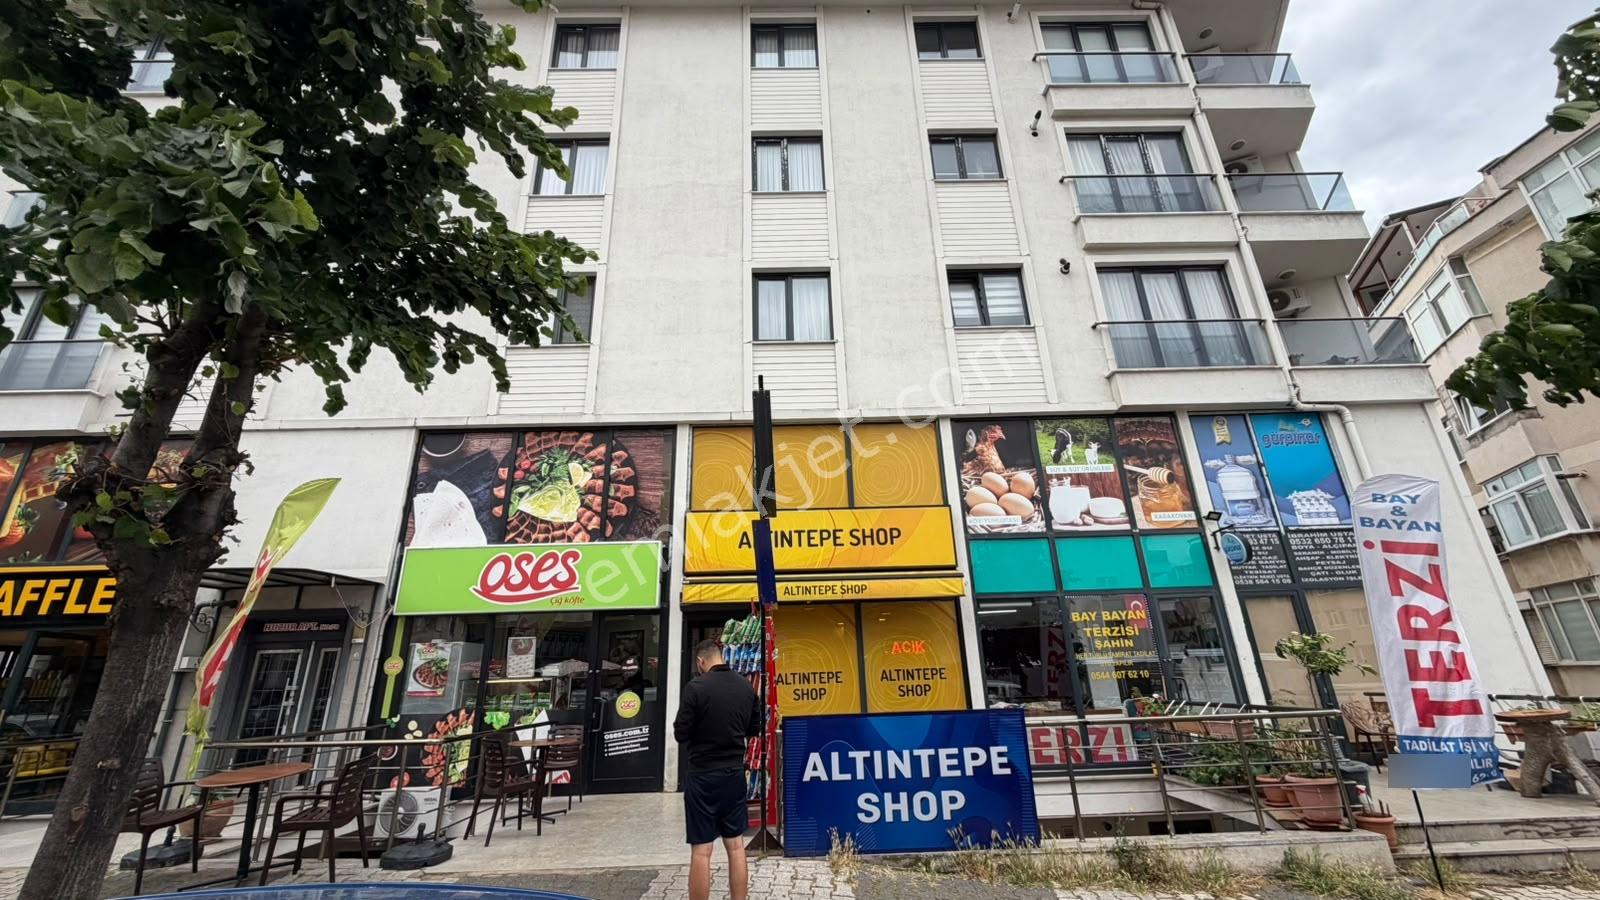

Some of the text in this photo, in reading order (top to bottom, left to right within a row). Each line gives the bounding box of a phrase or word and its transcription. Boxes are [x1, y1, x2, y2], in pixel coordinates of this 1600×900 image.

[1371, 493, 1421, 504] BAY
[1390, 505, 1407, 517] &
[1360, 517, 1441, 532] BAYAN
[738, 527, 902, 549] AINTEPE SHOP
[1287, 531, 1328, 539] İBRAHİM
[479, 549, 581, 596] oses
[783, 584, 868, 596] ALTINTEPE SHOP
[1071, 611, 1097, 622] BAY
[1102, 610, 1146, 620] BAYAN
[1083, 624, 1140, 637] TERZİSİ
[1363, 539, 1484, 729] TERZİ
[1095, 639, 1134, 650] ŞAHİN
[775, 671, 843, 685] ALTINTEPE
[880, 667, 947, 682] ALTINTEPE
[1128, 670, 1138, 678] 62
[1140, 670, 1150, 678] 10
[793, 687, 827, 701] SHOP
[898, 684, 932, 697] SHOP
[604, 727, 649, 740] oses.com.tr
[1403, 739, 1456, 752] TADİLAT
[802, 746, 1012, 782] ALTINTEPE
[857, 790, 966, 824] SHOP
